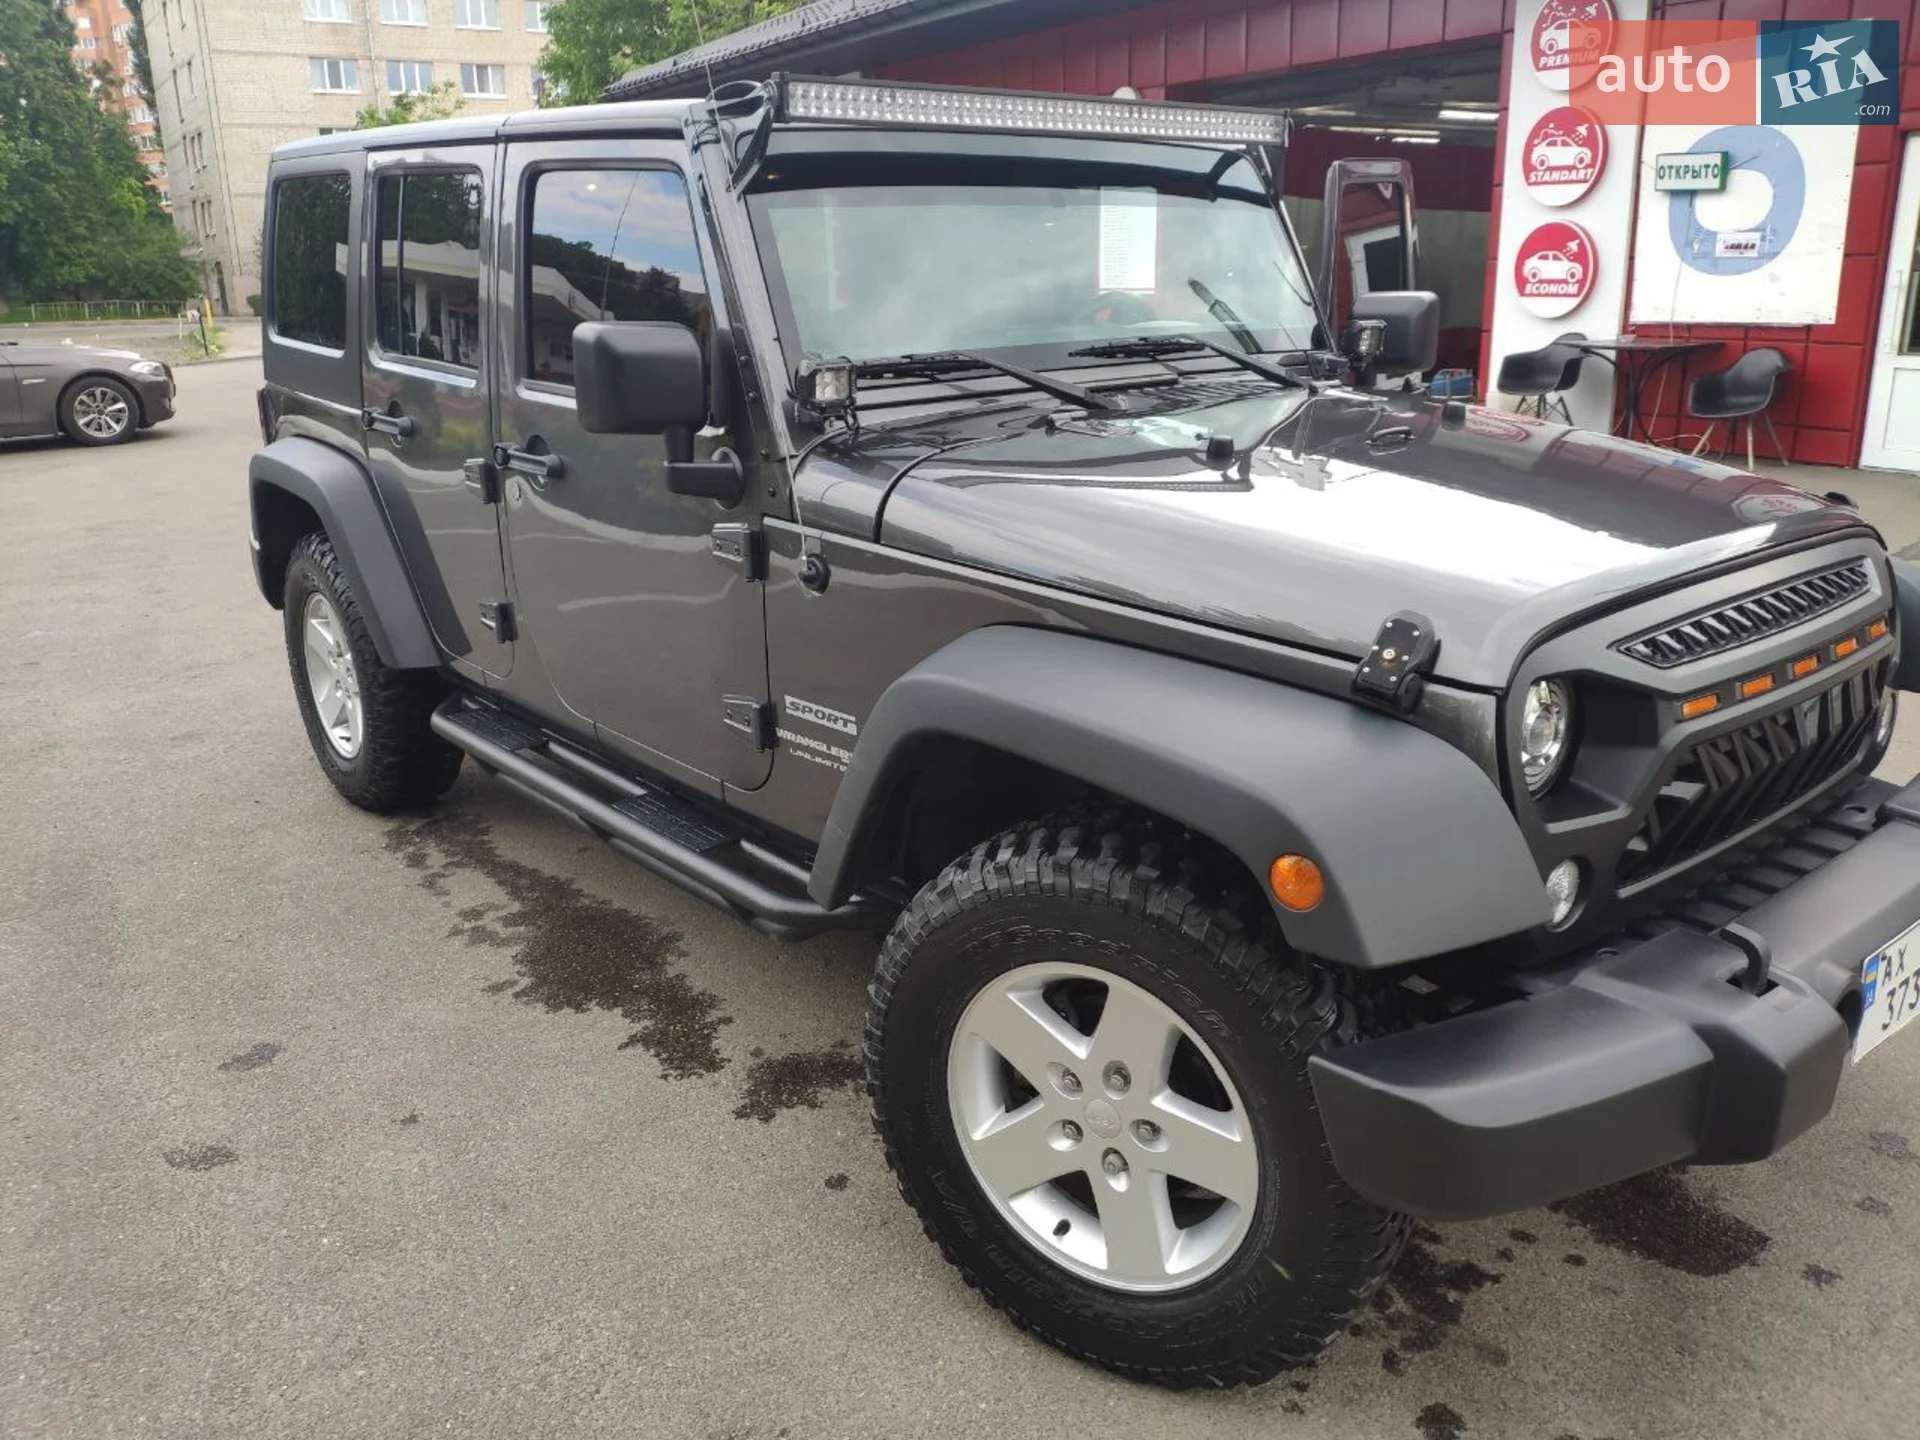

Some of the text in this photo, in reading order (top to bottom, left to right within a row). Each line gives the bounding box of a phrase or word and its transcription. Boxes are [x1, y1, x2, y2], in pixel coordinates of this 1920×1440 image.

[1538, 49, 1600, 68] PREMIUM
[1528, 167, 1593, 183] STANDART
[1658, 163, 1719, 180] ОТКРЫТО
[1524, 282, 1579, 295] ECONOM
[785, 700, 857, 729] SPORT
